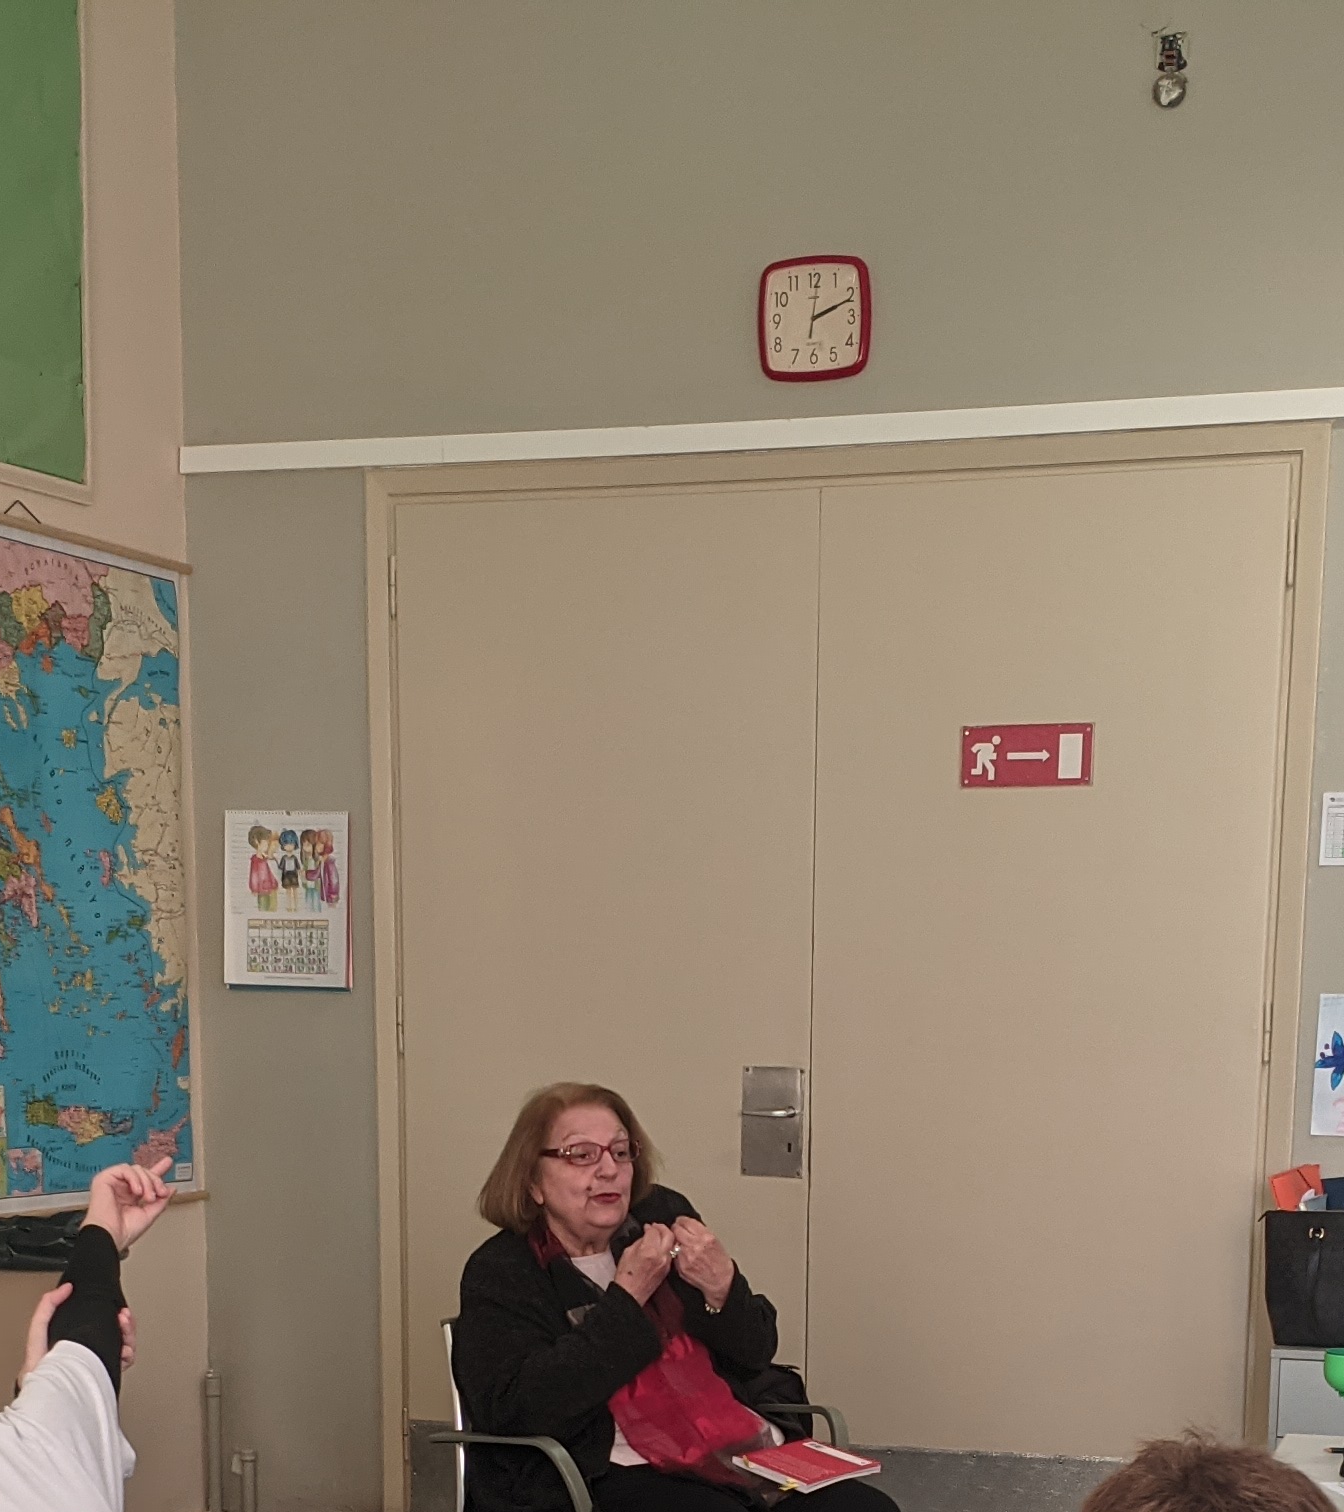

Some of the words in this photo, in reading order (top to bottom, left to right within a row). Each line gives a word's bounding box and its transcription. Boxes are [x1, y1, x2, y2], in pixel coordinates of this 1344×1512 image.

[788, 275, 799, 292] 11
[808, 272, 821, 289] 12
[832, 272, 837, 289] 1
[774, 291, 789, 308] 10
[846, 286, 855, 303] 2
[772, 313, 781, 330] 9
[847, 308, 856, 325] 3
[773, 336, 782, 353] 8
[844, 332, 854, 348] 4
[790, 348, 800, 365] 7
[809, 347, 819, 364] 6
[829, 346, 838, 363] 5
